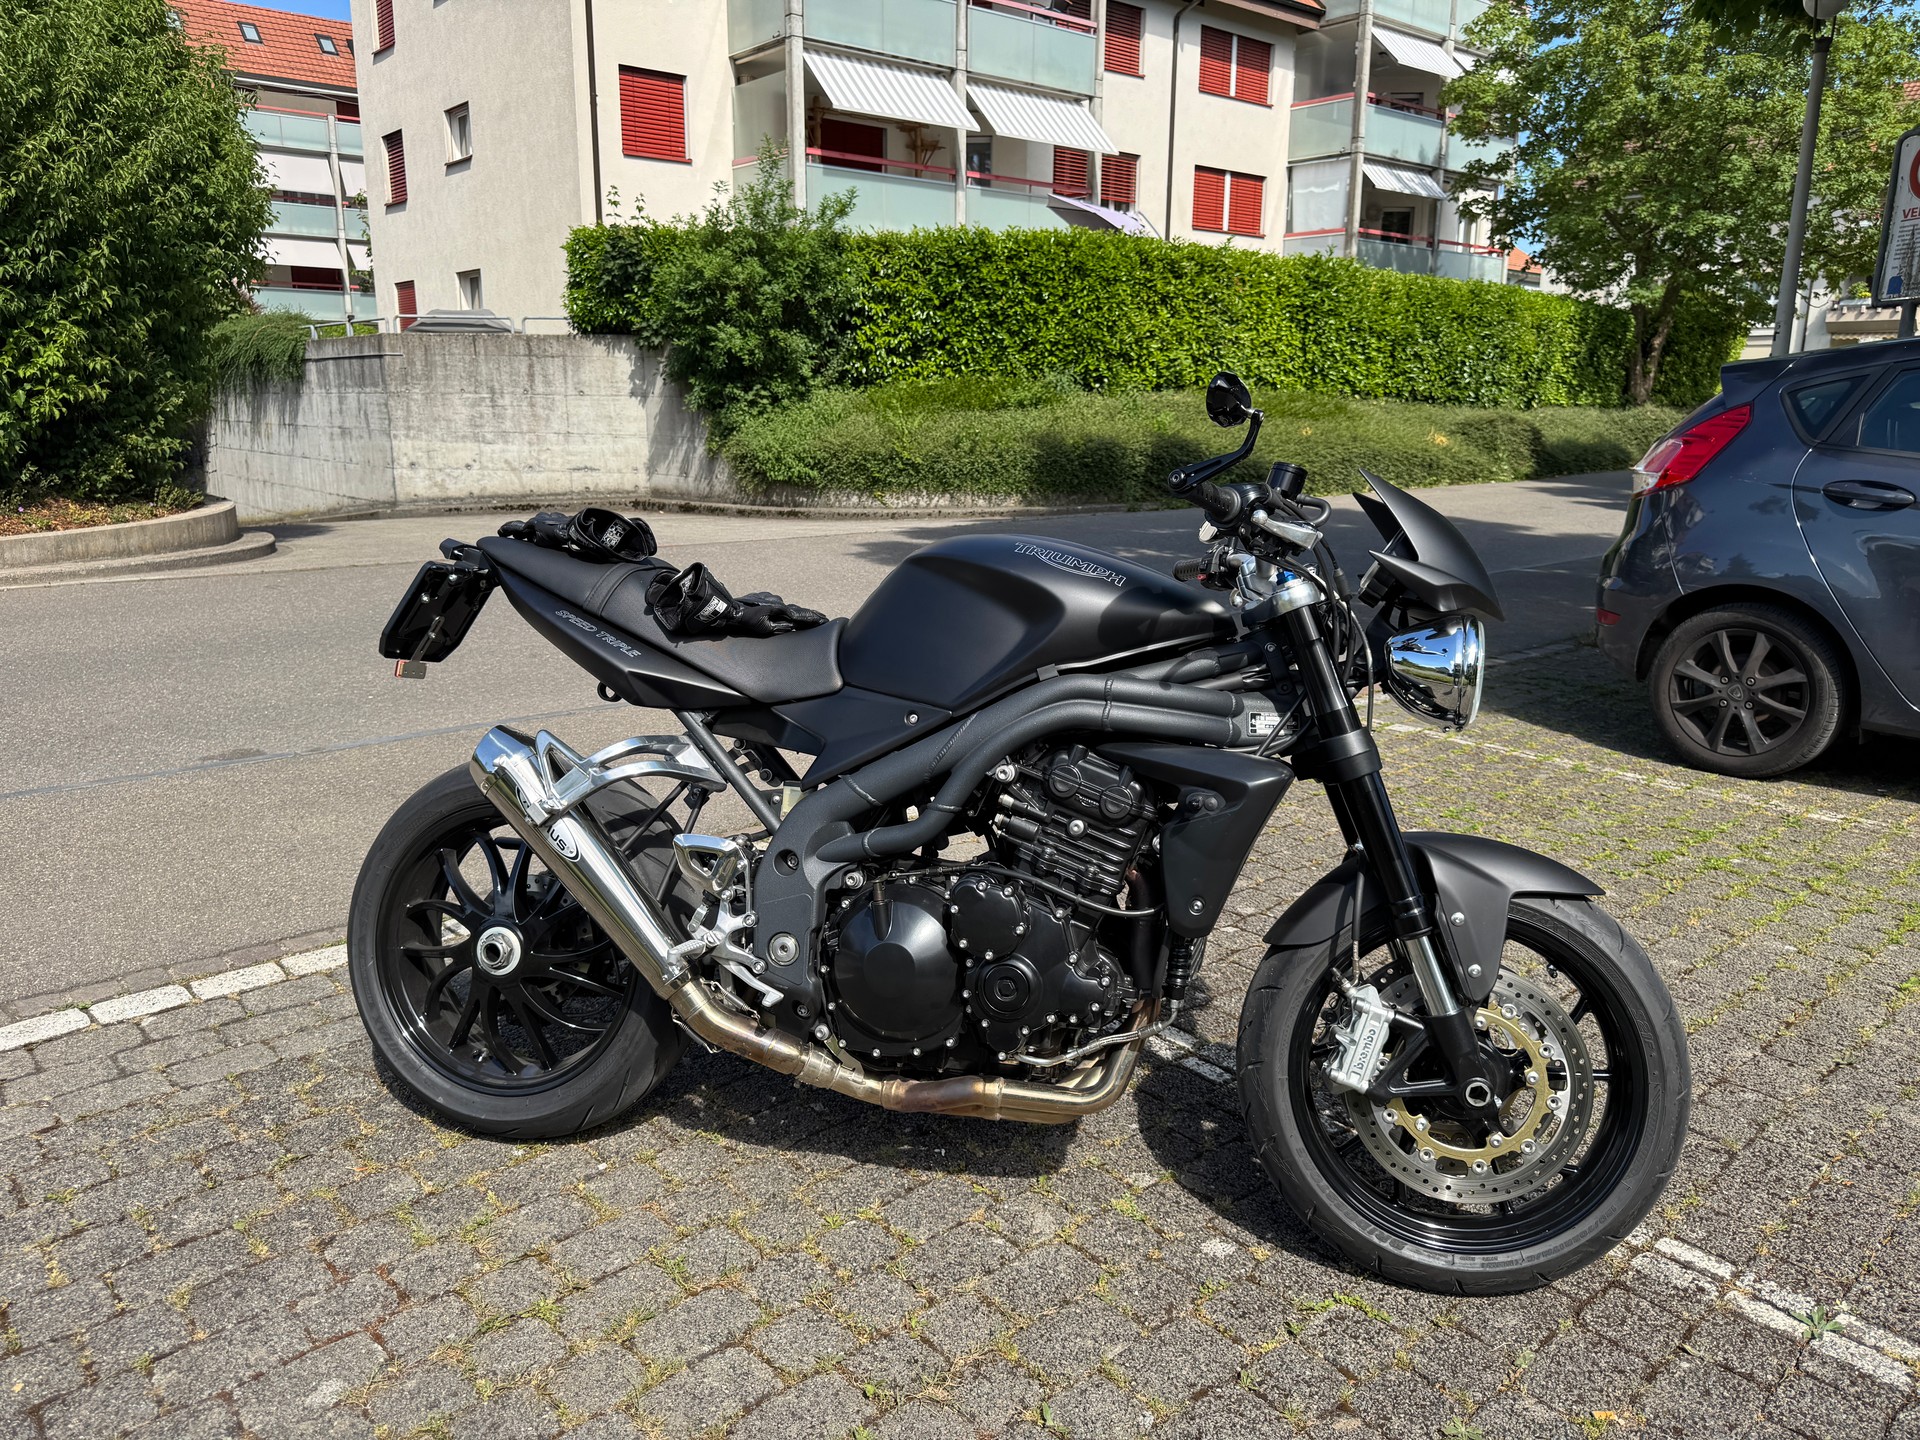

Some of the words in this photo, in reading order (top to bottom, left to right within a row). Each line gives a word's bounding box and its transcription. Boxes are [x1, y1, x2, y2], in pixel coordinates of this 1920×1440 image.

[1014, 542, 1127, 587] TRIUMPH
[555, 610, 598, 632] SPEED
[596, 631, 642, 658] TRIPLE
[1354, 1028, 1377, 1070] brembo
